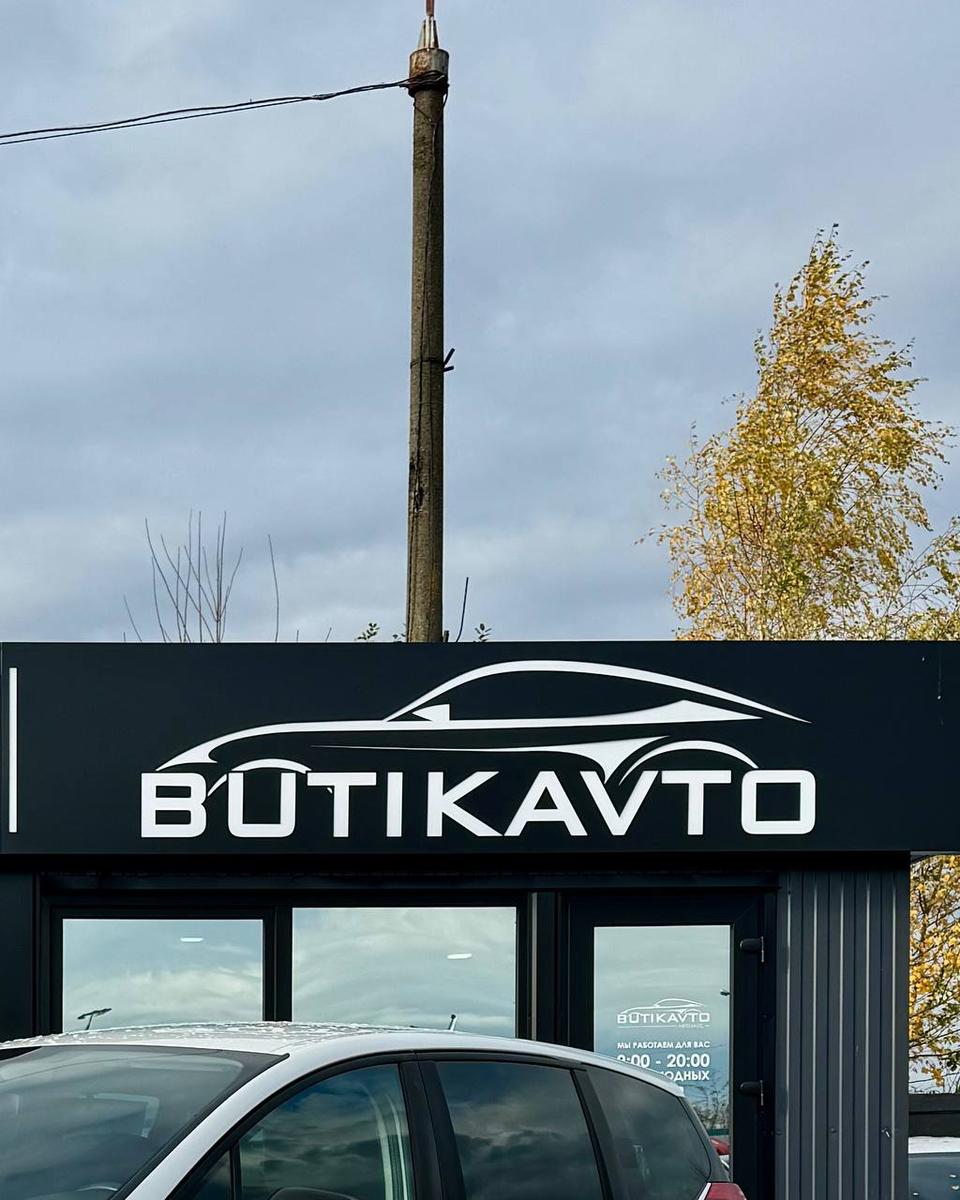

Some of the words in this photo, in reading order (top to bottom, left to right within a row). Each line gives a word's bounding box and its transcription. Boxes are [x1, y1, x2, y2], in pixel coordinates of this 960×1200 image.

[140, 770, 816, 838] BUTIKAVTO
[617, 1013, 711, 1024] BUTIKAVTO
[632, 1041, 674, 1049] РАБОТАЕМ
[675, 1041, 692, 1049] ДЛЯ
[666, 1053, 710, 1068] 20:00
[660, 1070, 710, 1082] ОДНЫХ
